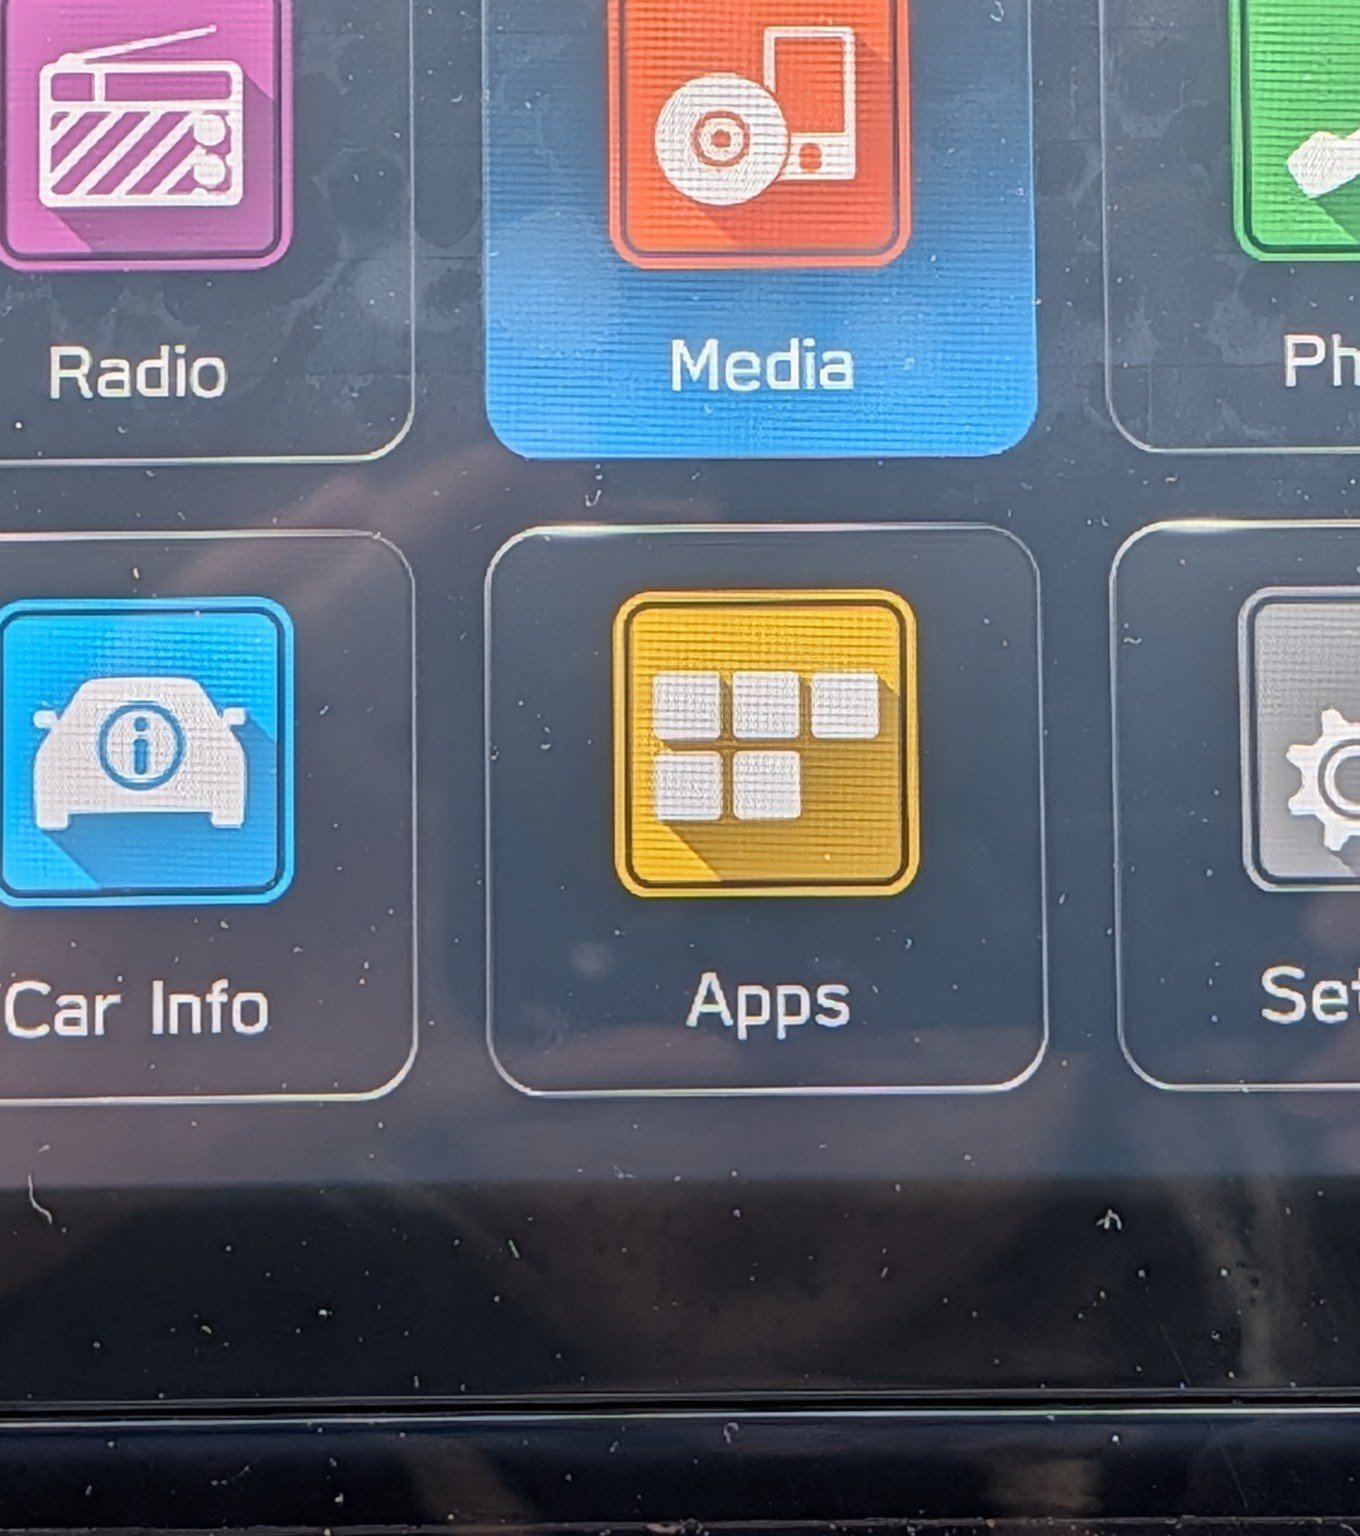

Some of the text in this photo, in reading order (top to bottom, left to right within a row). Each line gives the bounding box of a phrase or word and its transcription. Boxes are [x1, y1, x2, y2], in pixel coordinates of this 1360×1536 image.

[49, 344, 227, 400] Radio
[670, 337, 855, 393] Media
[3, 978, 269, 1039] Car Info
[686, 972, 851, 1041] Apps
